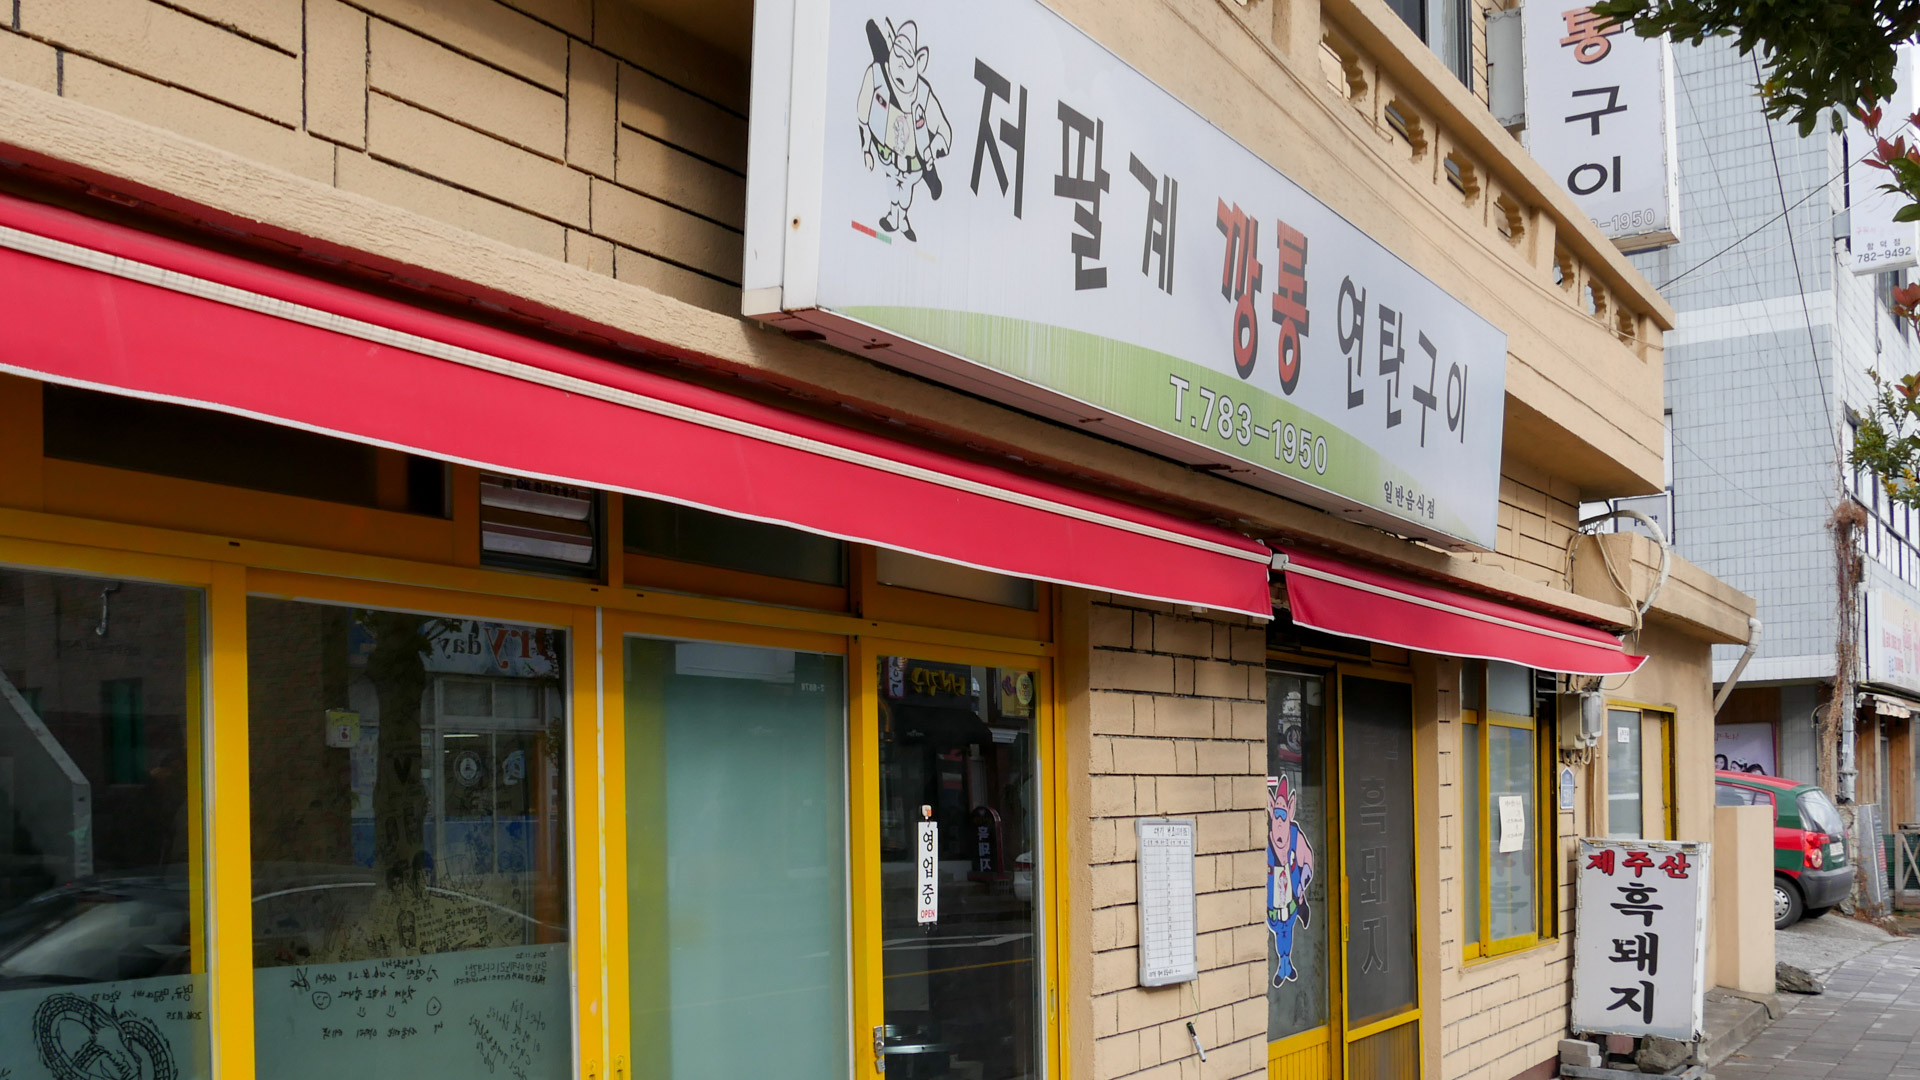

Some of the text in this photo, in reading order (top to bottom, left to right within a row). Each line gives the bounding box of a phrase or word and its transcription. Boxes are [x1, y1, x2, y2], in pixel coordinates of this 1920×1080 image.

[969, 57, 1468, 448] 저팔계 깡통 연탄구이
[1857, 246, 1911, 264] 782-9492
[1383, 480, 1435, 520] 일반음식점
[922, 830, 935, 905] 영업중
[1586, 849, 1691, 879] 제주산
[920, 909, 936, 919] OPEN
[1606, 882, 1664, 1024] 흑돼지
